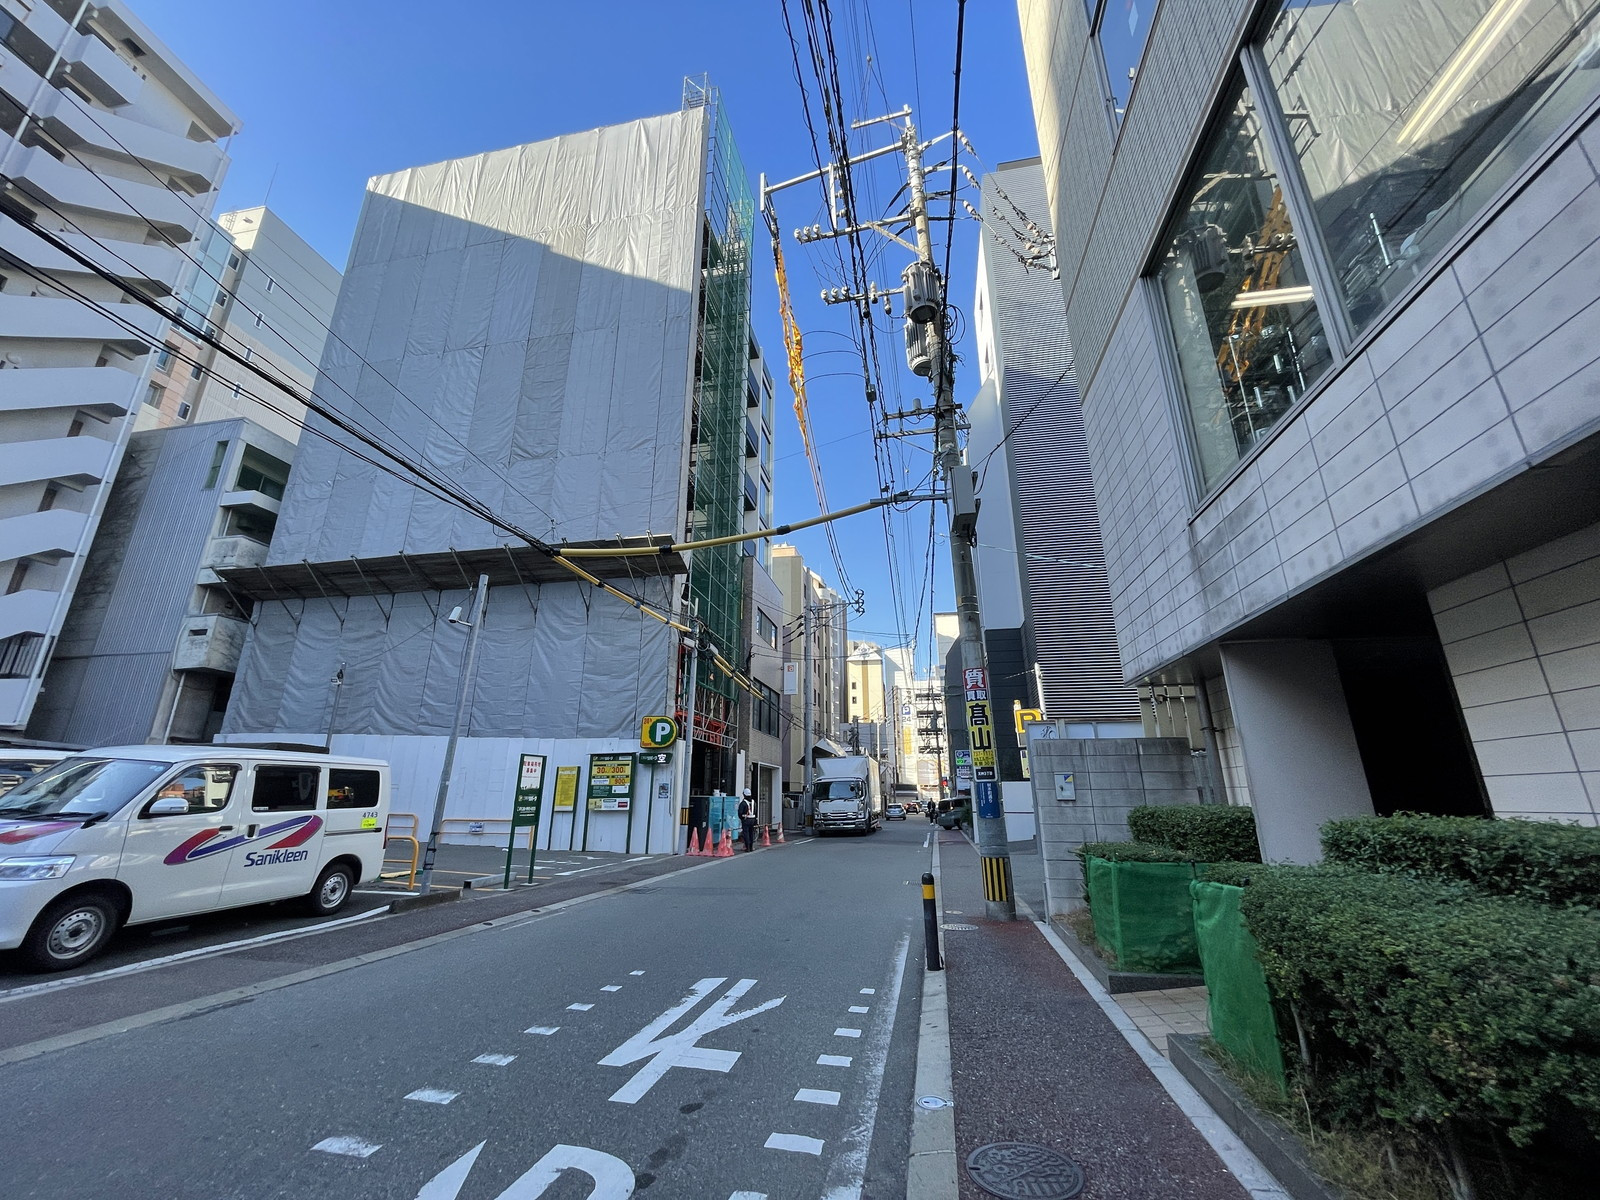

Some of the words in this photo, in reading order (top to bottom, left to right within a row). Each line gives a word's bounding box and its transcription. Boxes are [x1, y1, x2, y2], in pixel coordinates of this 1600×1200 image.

[965, 668, 984, 689] 質
[967, 690, 986, 701] 買取
[655, 722, 671, 742] P
[970, 703, 992, 751] 高山
[657, 753, 666, 763] 空
[244, 849, 309, 867] Sanikleen
